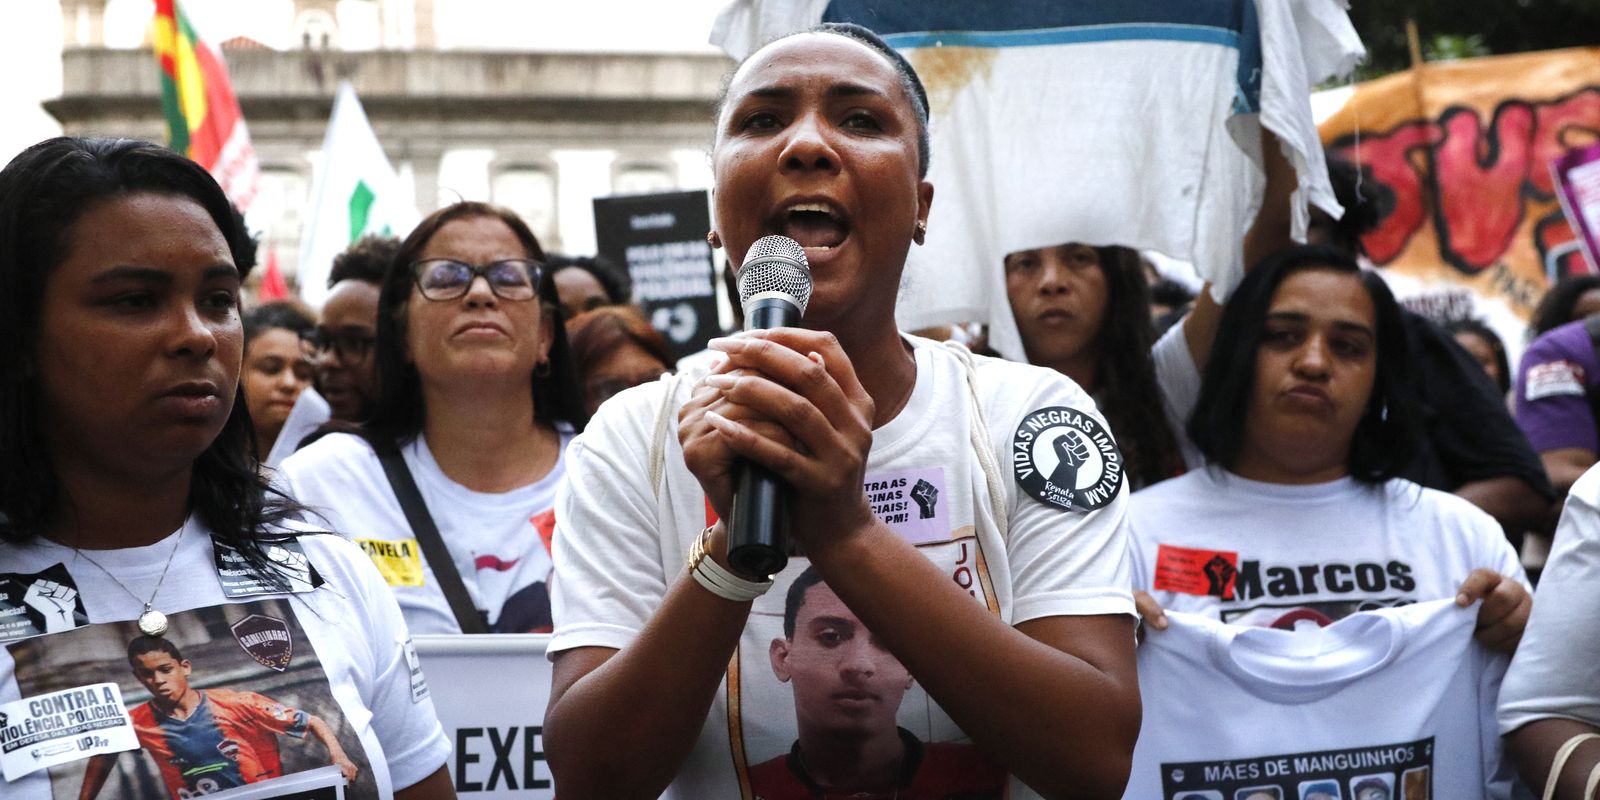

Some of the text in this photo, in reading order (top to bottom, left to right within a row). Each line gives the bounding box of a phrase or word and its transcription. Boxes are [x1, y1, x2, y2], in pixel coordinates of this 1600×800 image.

[1014, 410, 1120, 506] VIDAS NEGRAS IMPORTAM
[890, 478, 907, 488] AS
[1045, 481, 1074, 500] Renata
[1046, 492, 1072, 507] Souza
[885, 513, 909, 524] PM!
[1221, 560, 1416, 602] Marcos
[29, 686, 116, 718] CONTRA A
[0, 714, 65, 744] VIOLÊNCIA
[67, 704, 123, 725] POLICIAL
[5, 719, 124, 751] EM DEFESA DAS VIDAS NEGRAS
[76, 736, 94, 751] UP
[455, 726, 550, 793] EXE
[1204, 746, 1415, 782] MÃES DE MANGUINHOS
